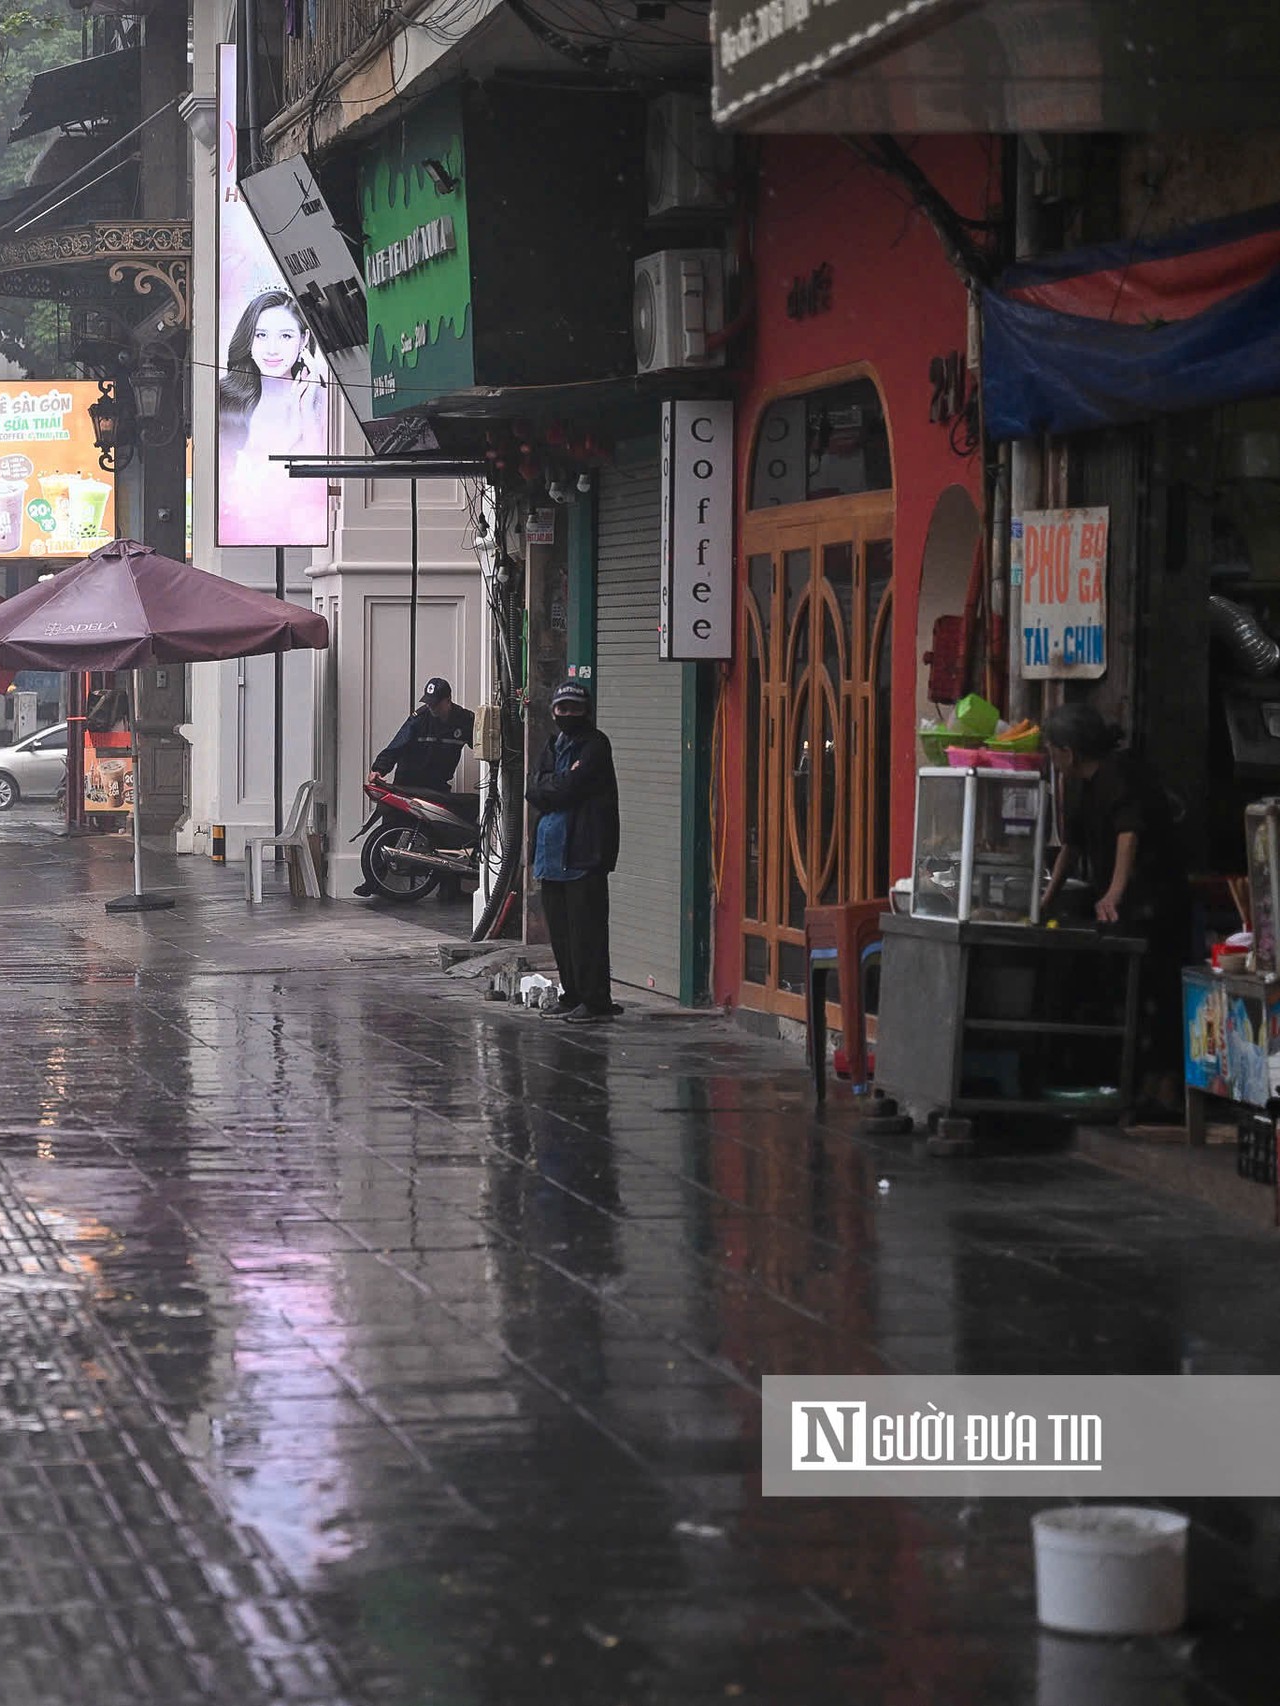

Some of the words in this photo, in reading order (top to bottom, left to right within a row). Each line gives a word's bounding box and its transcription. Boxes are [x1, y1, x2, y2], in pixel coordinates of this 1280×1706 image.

[12, 394, 35, 414] SÀI
[40, 392, 71, 412] GÒN
[0, 432, 24, 440] COFFEE
[31, 412, 61, 430] THÁI
[691, 417, 714, 640] Coffee
[1080, 515, 1107, 559] BÒ
[1078, 561, 1103, 604] GÀ
[63, 621, 118, 632] ADELA
[1024, 617, 1050, 666] TÁI
[1063, 616, 1104, 665] CHÍN
